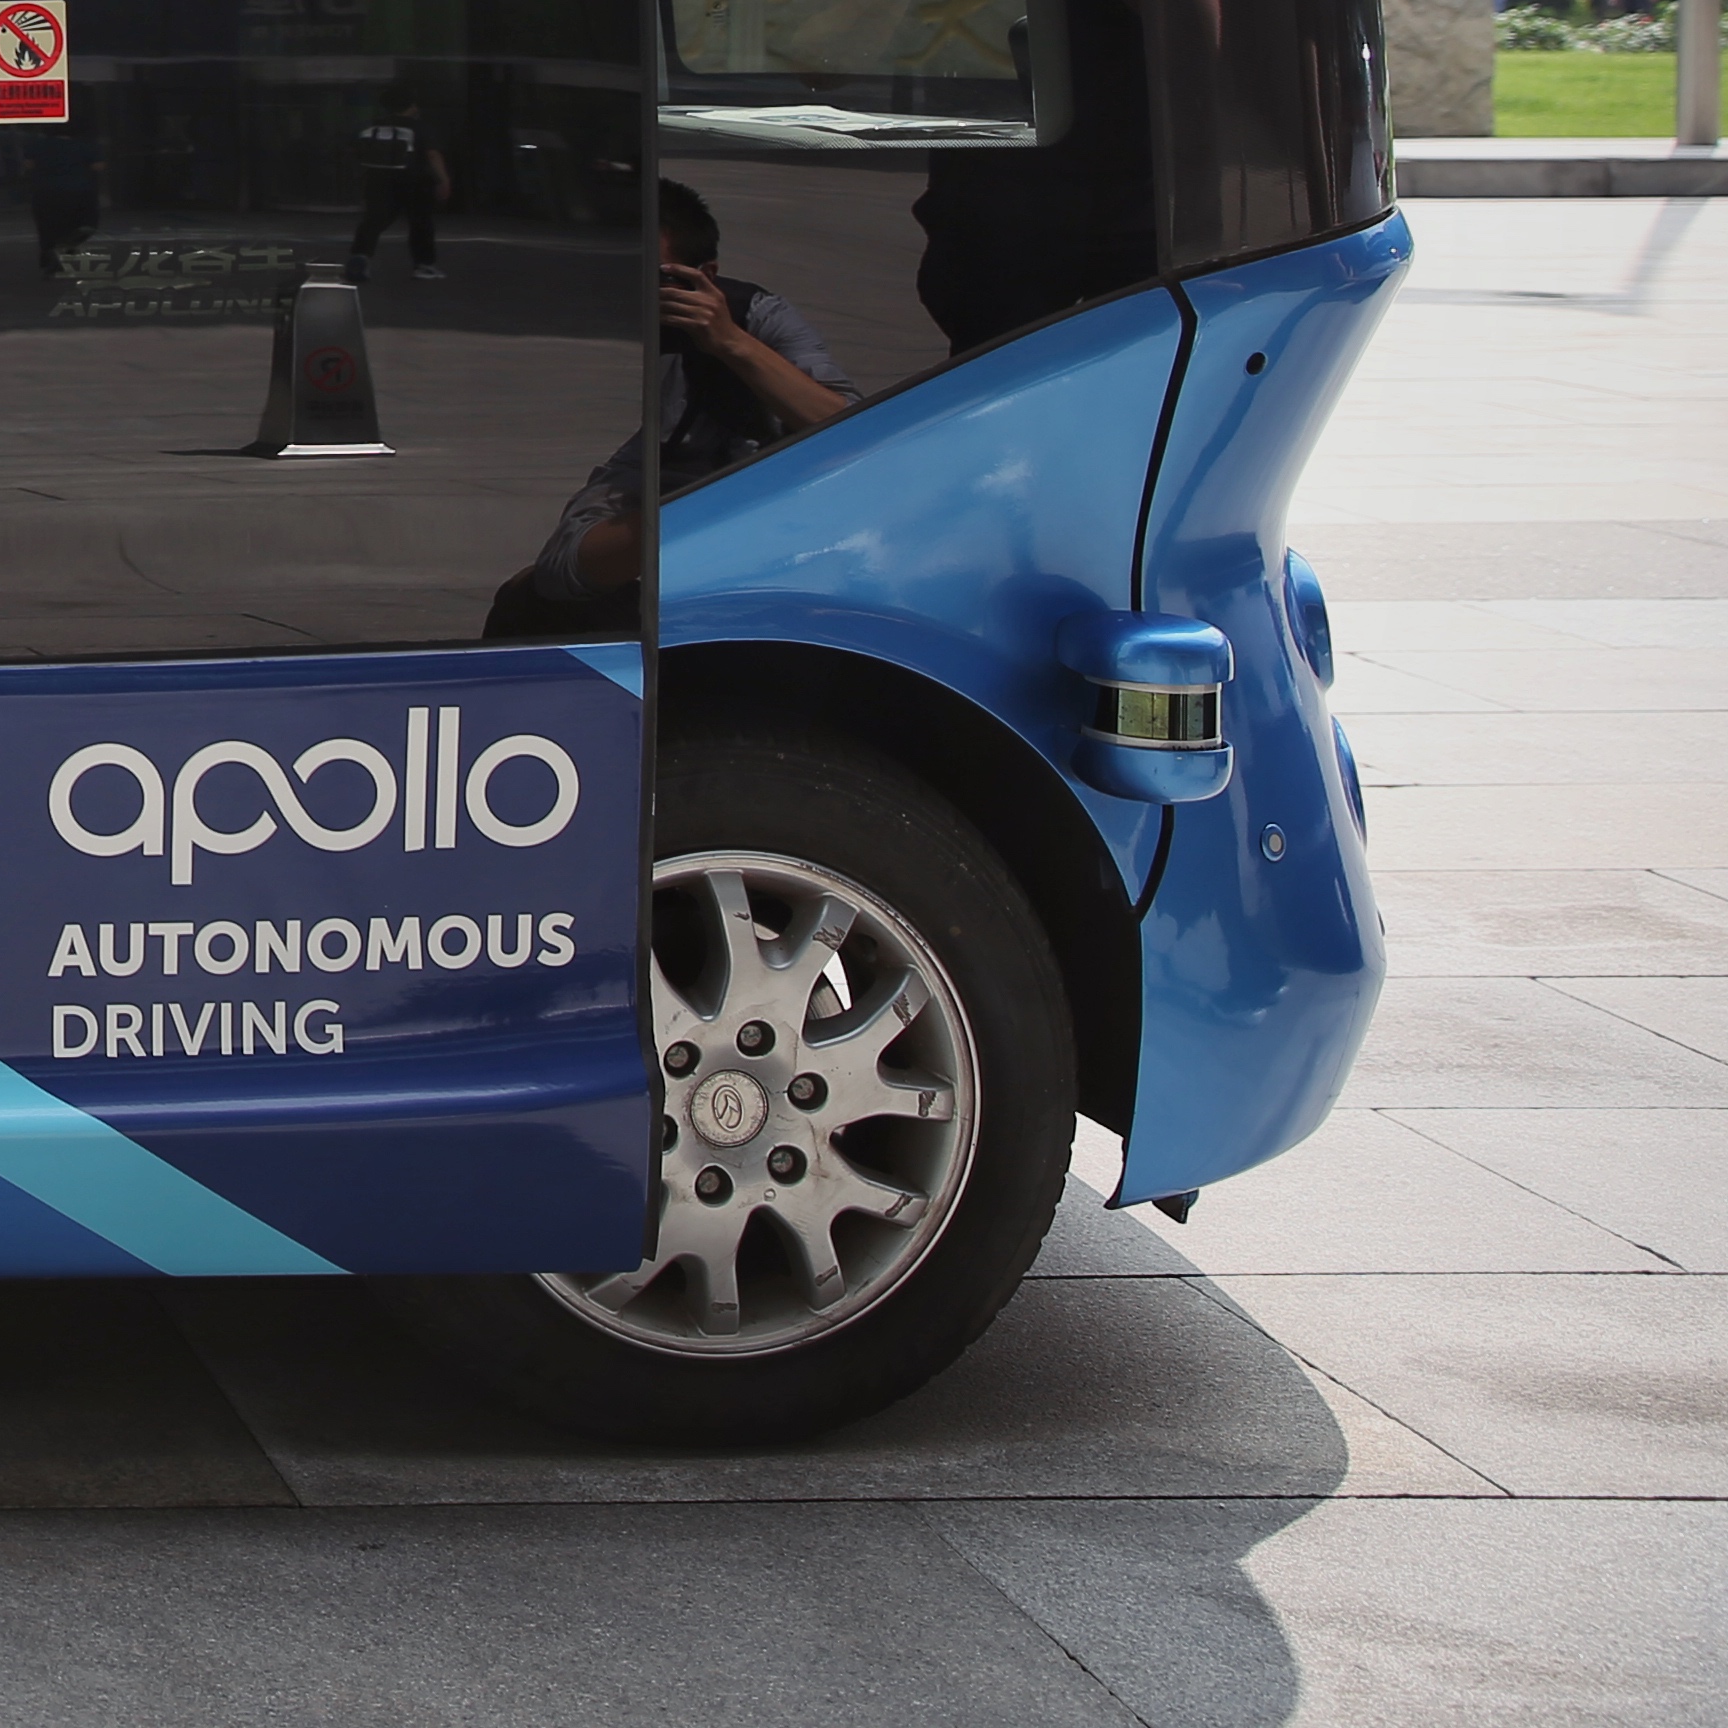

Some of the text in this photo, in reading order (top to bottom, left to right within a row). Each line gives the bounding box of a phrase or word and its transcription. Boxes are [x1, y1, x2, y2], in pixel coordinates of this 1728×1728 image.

[48, 706, 580, 885] apollo
[48, 912, 575, 977] AUTONOMOUS
[52, 1000, 344, 1058] DRIVING
